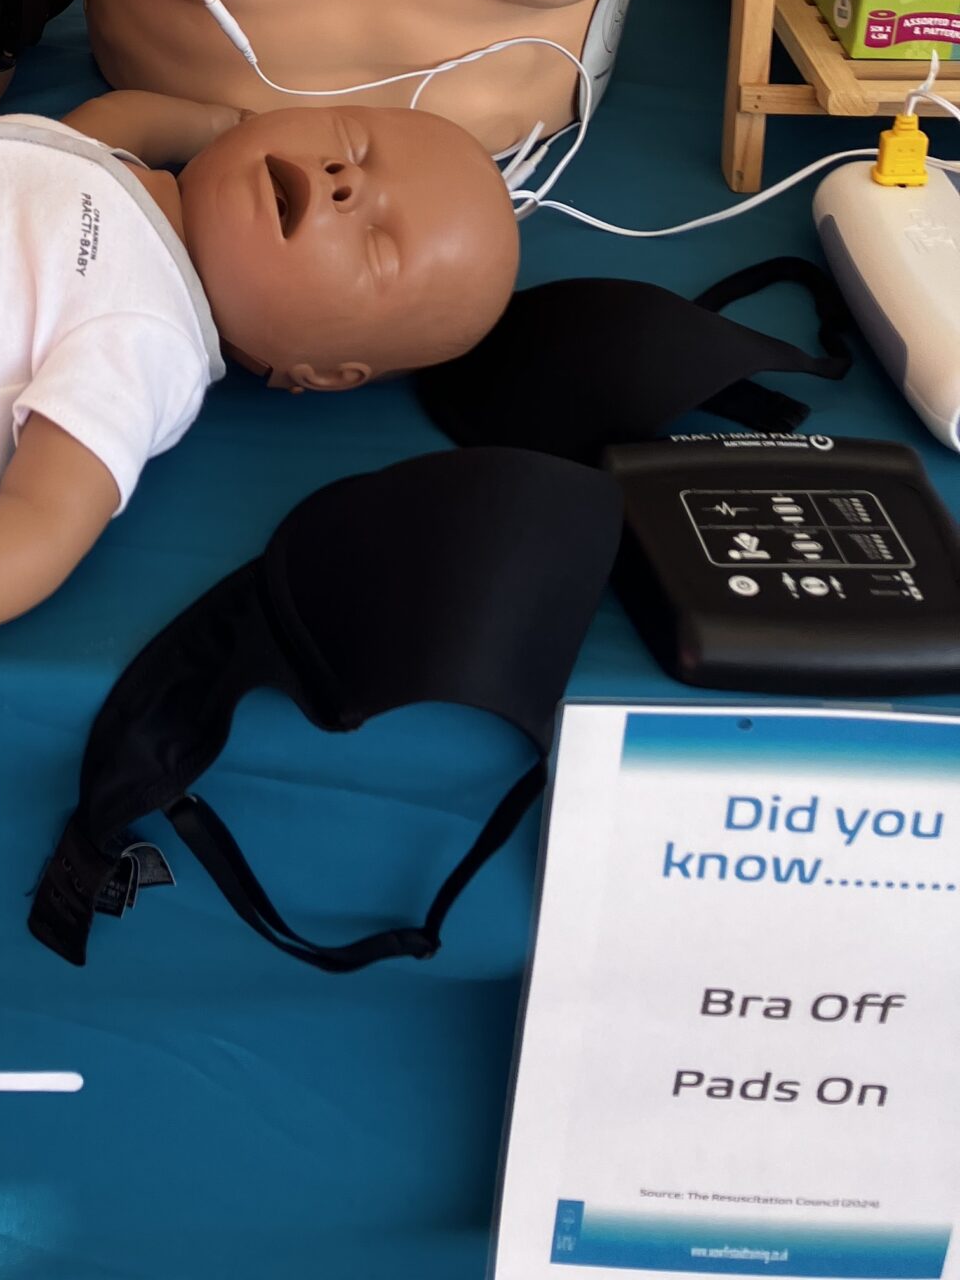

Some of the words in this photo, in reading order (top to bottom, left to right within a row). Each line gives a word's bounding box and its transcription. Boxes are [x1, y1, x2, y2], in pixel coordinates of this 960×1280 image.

[75, 192, 92, 277] PRACTI-BABY
[724, 794, 820, 834] Did
[835, 806, 944, 846] you
[700, 987, 793, 1021] Bra
[810, 992, 908, 1025] Off
[672, 1069, 802, 1103] Pads
[815, 1076, 890, 1108] On
[639, 1189, 685, 1201] Source:
[688, 1192, 710, 1202] The
[711, 1193, 793, 1206] Resuscitation
[794, 1197, 841, 1208] Council
